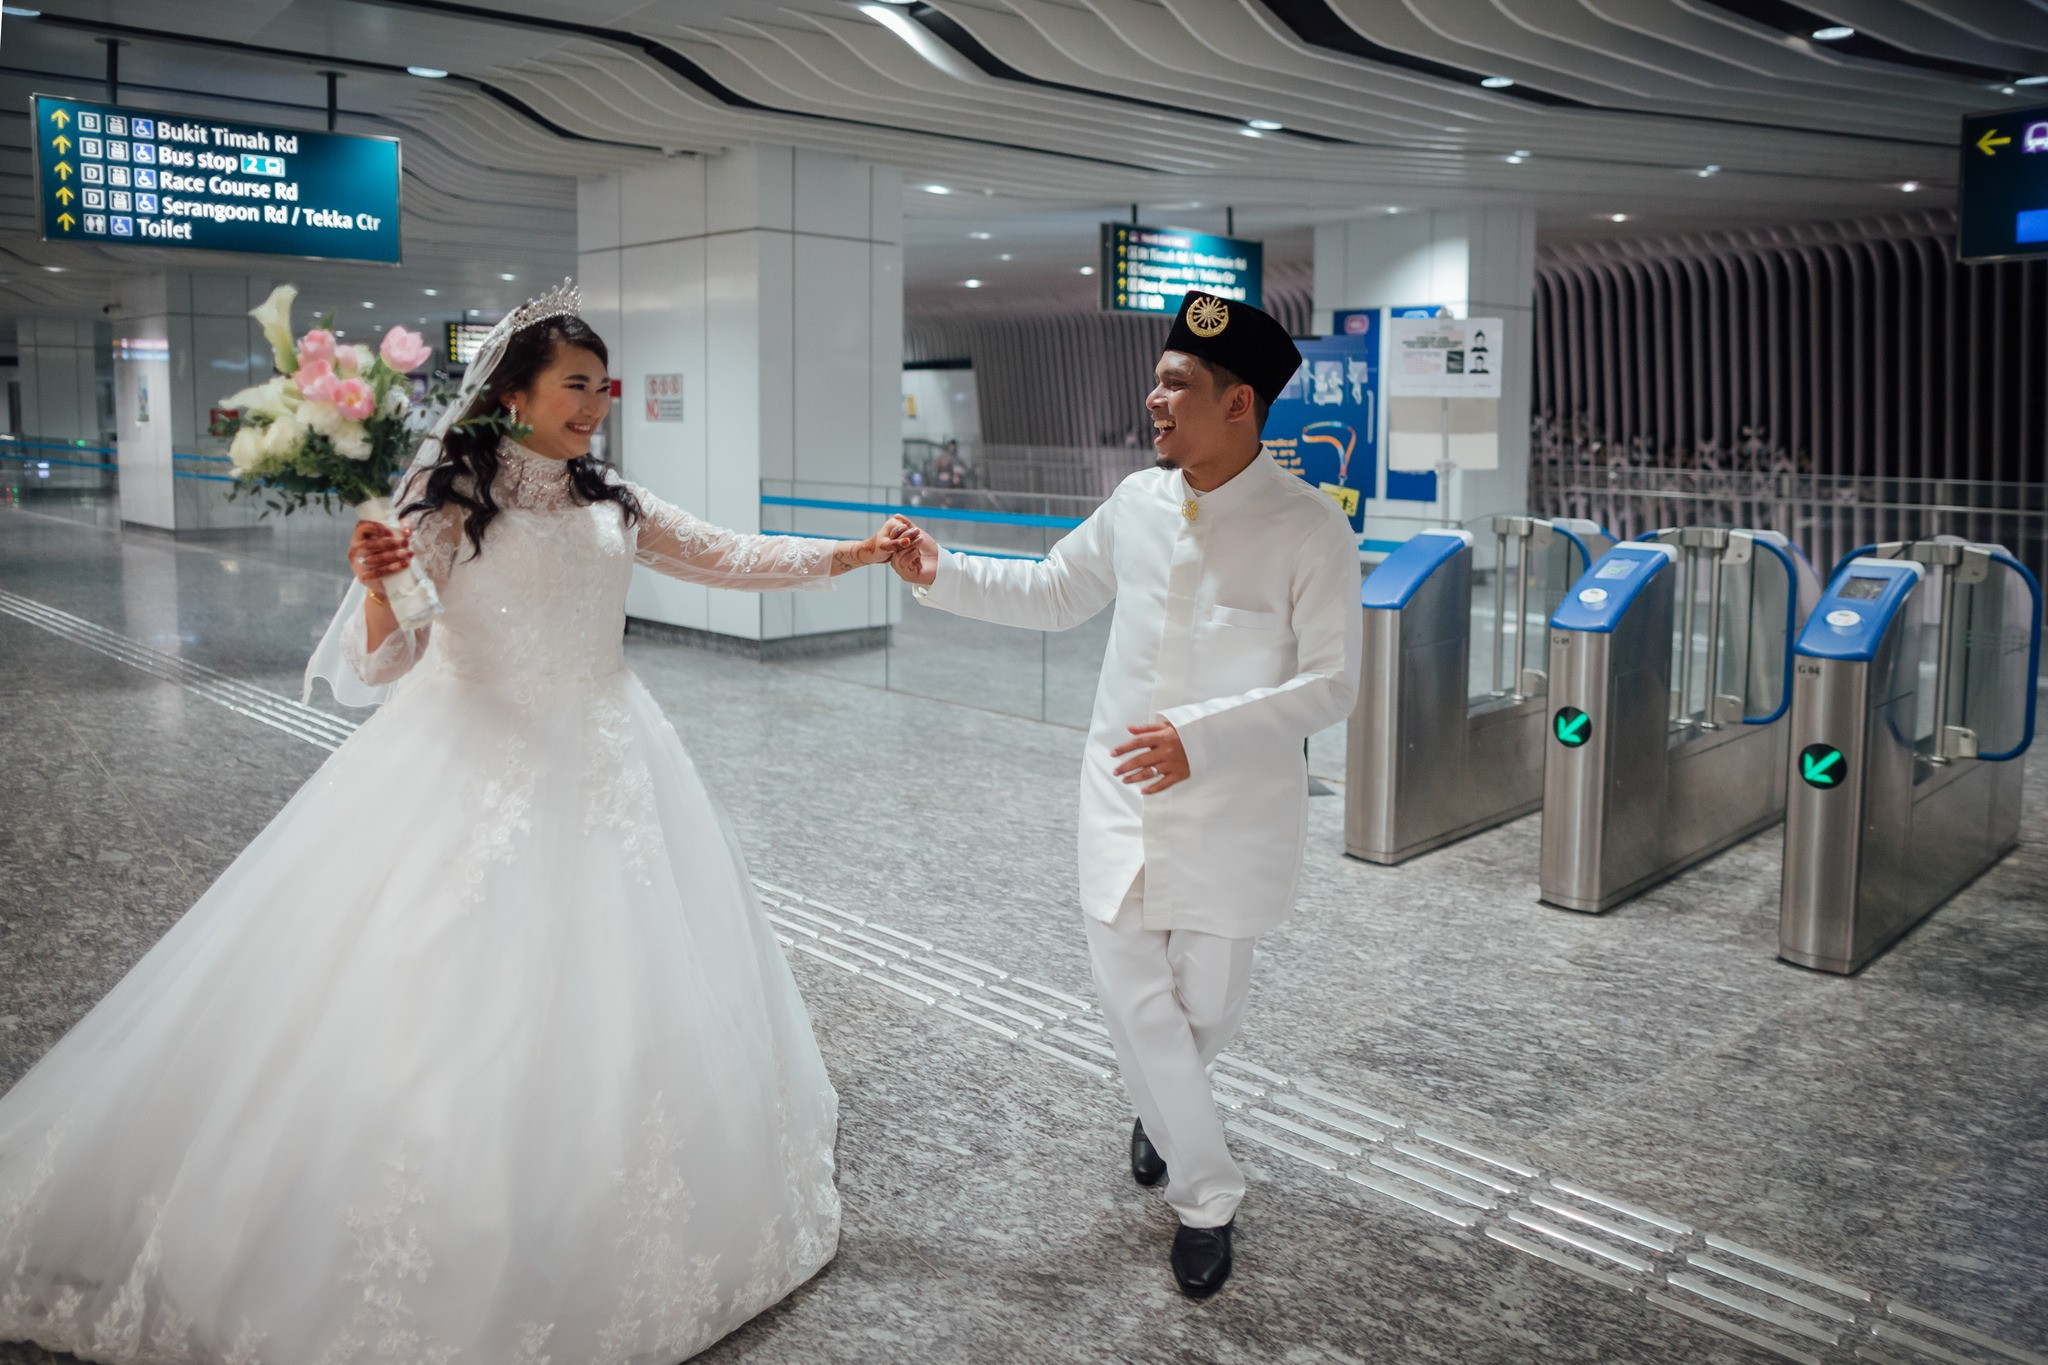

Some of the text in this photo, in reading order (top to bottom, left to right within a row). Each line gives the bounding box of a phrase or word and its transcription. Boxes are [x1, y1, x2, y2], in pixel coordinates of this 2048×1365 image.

[84, 116, 298, 154] B Bukit Timah Rd
[85, 142, 258, 174] B Bus stop 2
[86, 168, 298, 201] D Race Course Rd
[87, 193, 382, 231] D Serangoon Rd / Tekka Ctr
[137, 218, 192, 240] Toilet
